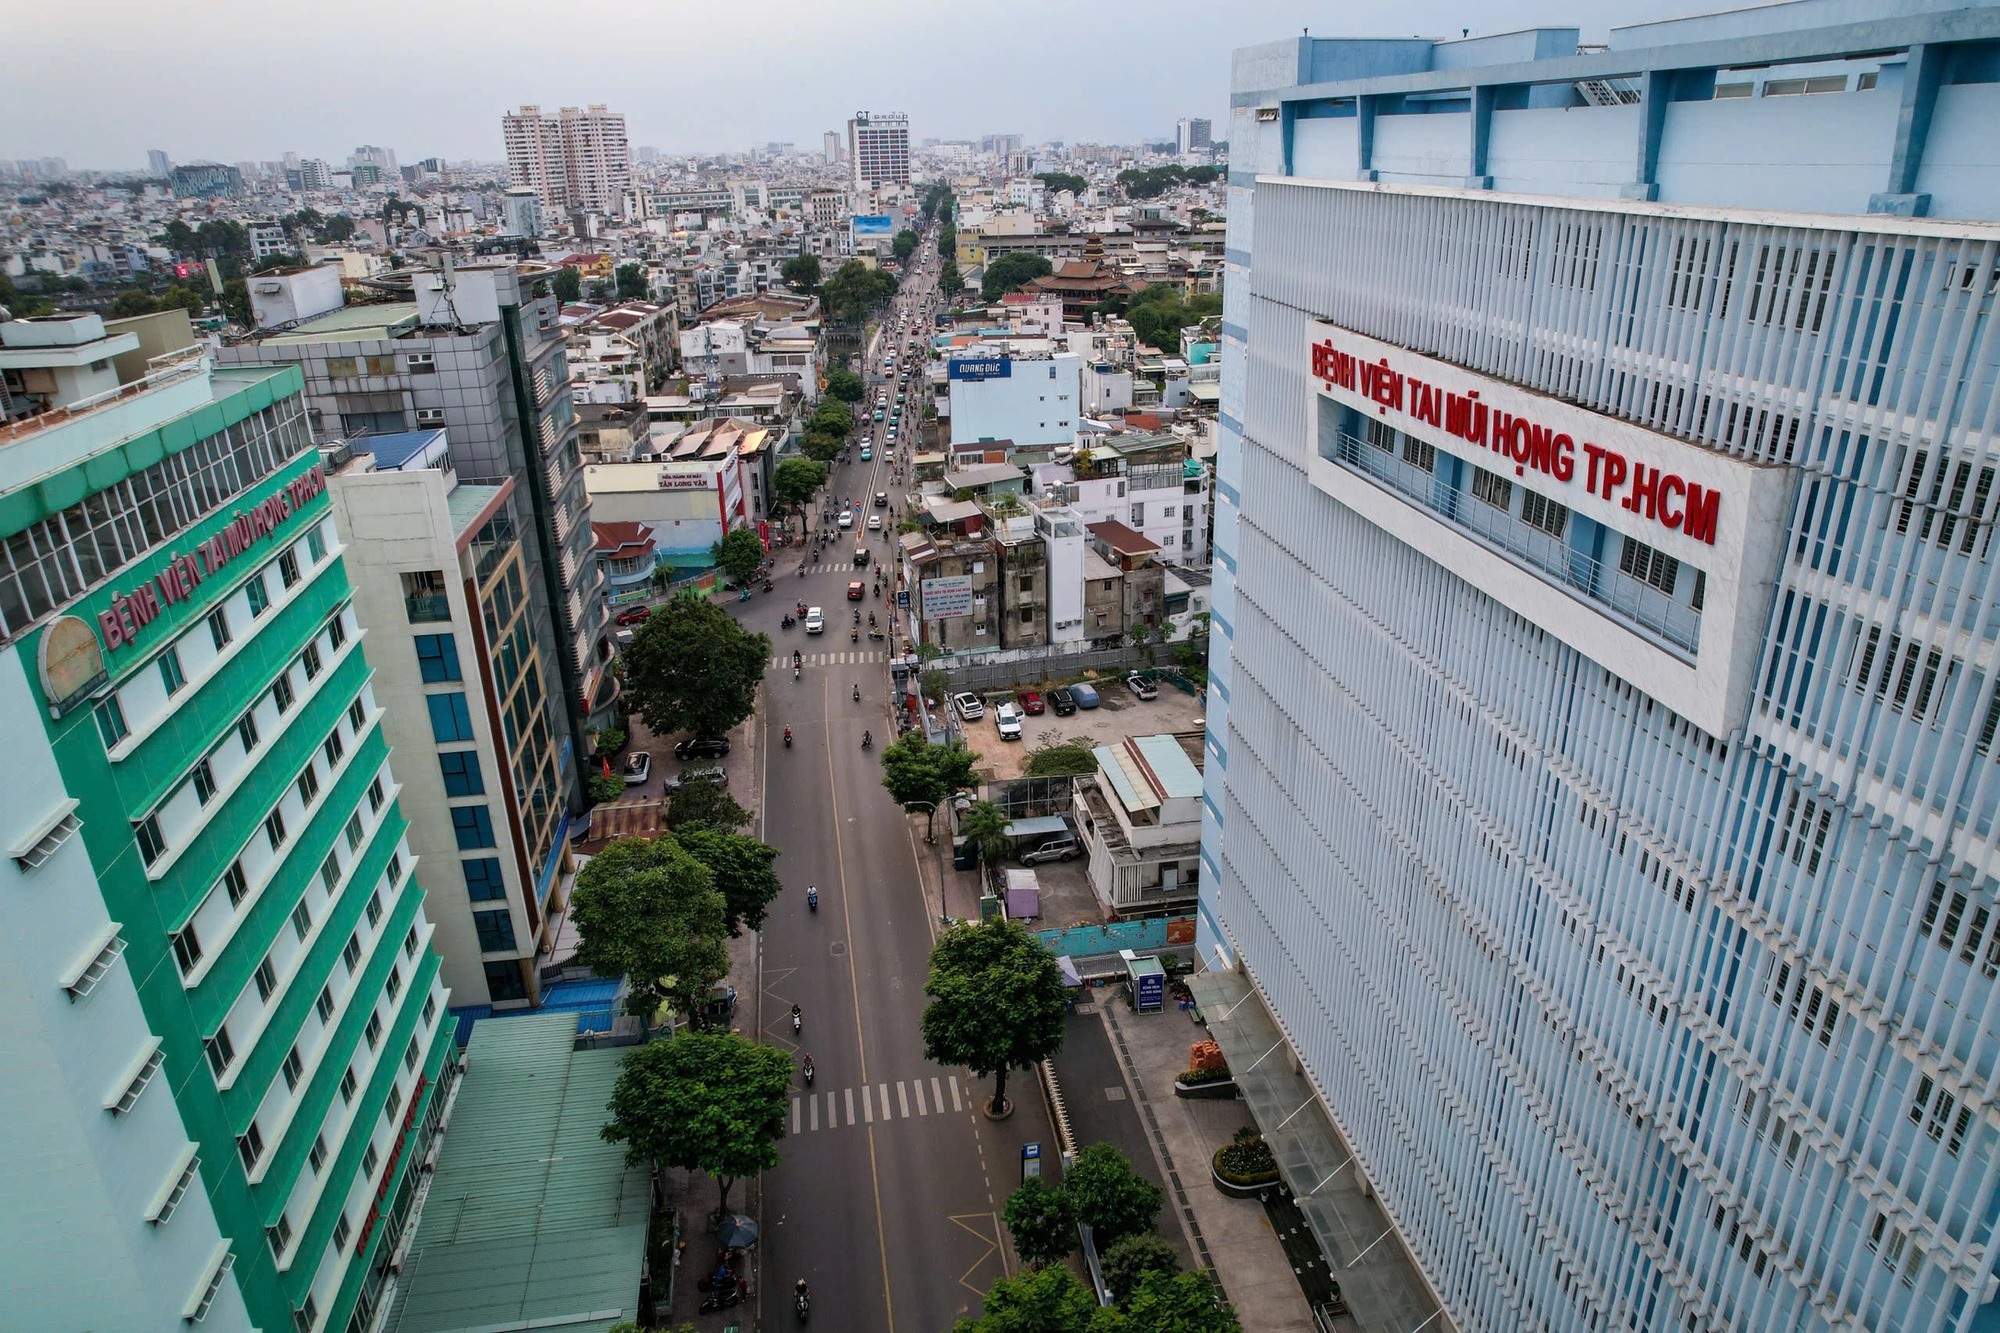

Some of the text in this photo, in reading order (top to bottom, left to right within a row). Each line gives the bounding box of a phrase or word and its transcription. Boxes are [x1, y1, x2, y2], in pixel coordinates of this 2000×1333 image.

[856, 111, 869, 119] CT
[960, 364, 984, 373] QUANG
[1312, 339, 1720, 546] BỆNH VIỆN TAI MŨI HỌNG TP.HCM
[98, 581, 161, 652] BỆNH
[155, 551, 203, 607] VIỆN
[197, 532, 229, 575] TAI
[224, 510, 256, 558] MŨI
[250, 489, 291, 538] HỌNG
